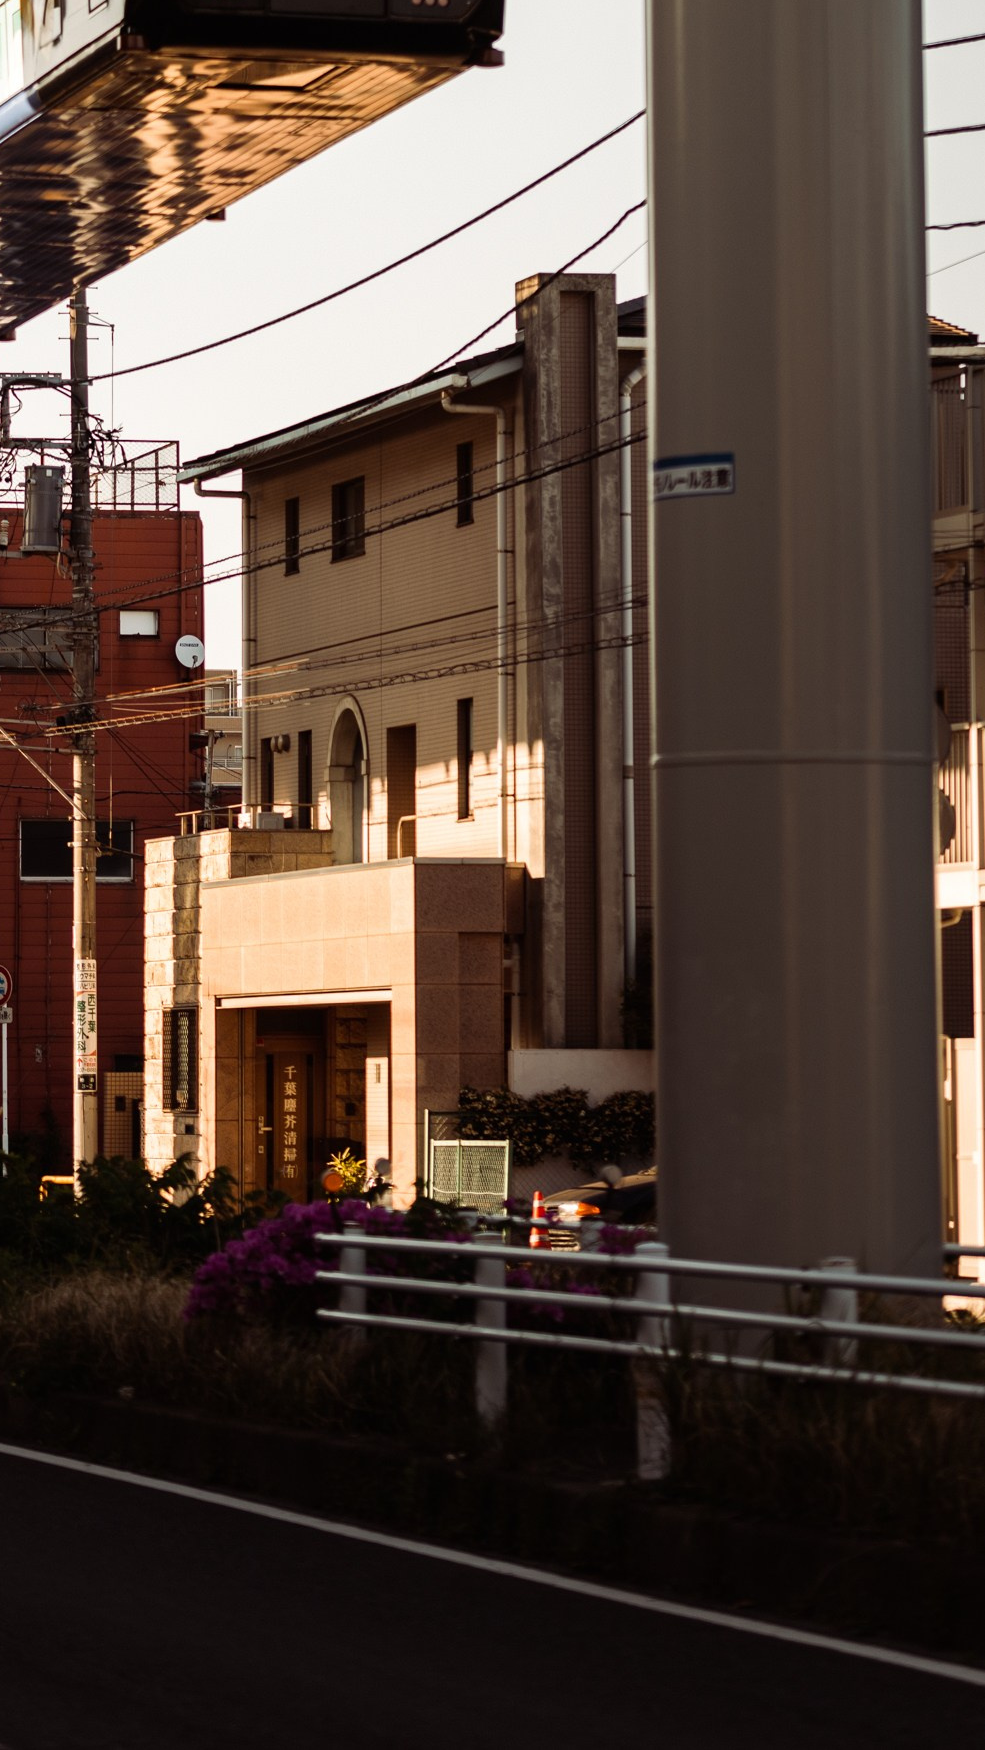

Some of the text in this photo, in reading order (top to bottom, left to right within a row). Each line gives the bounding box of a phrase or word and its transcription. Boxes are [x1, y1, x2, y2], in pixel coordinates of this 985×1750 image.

[76, 1000, 88, 1053] 整形外科
[87, 993, 96, 1033] 西千葉
